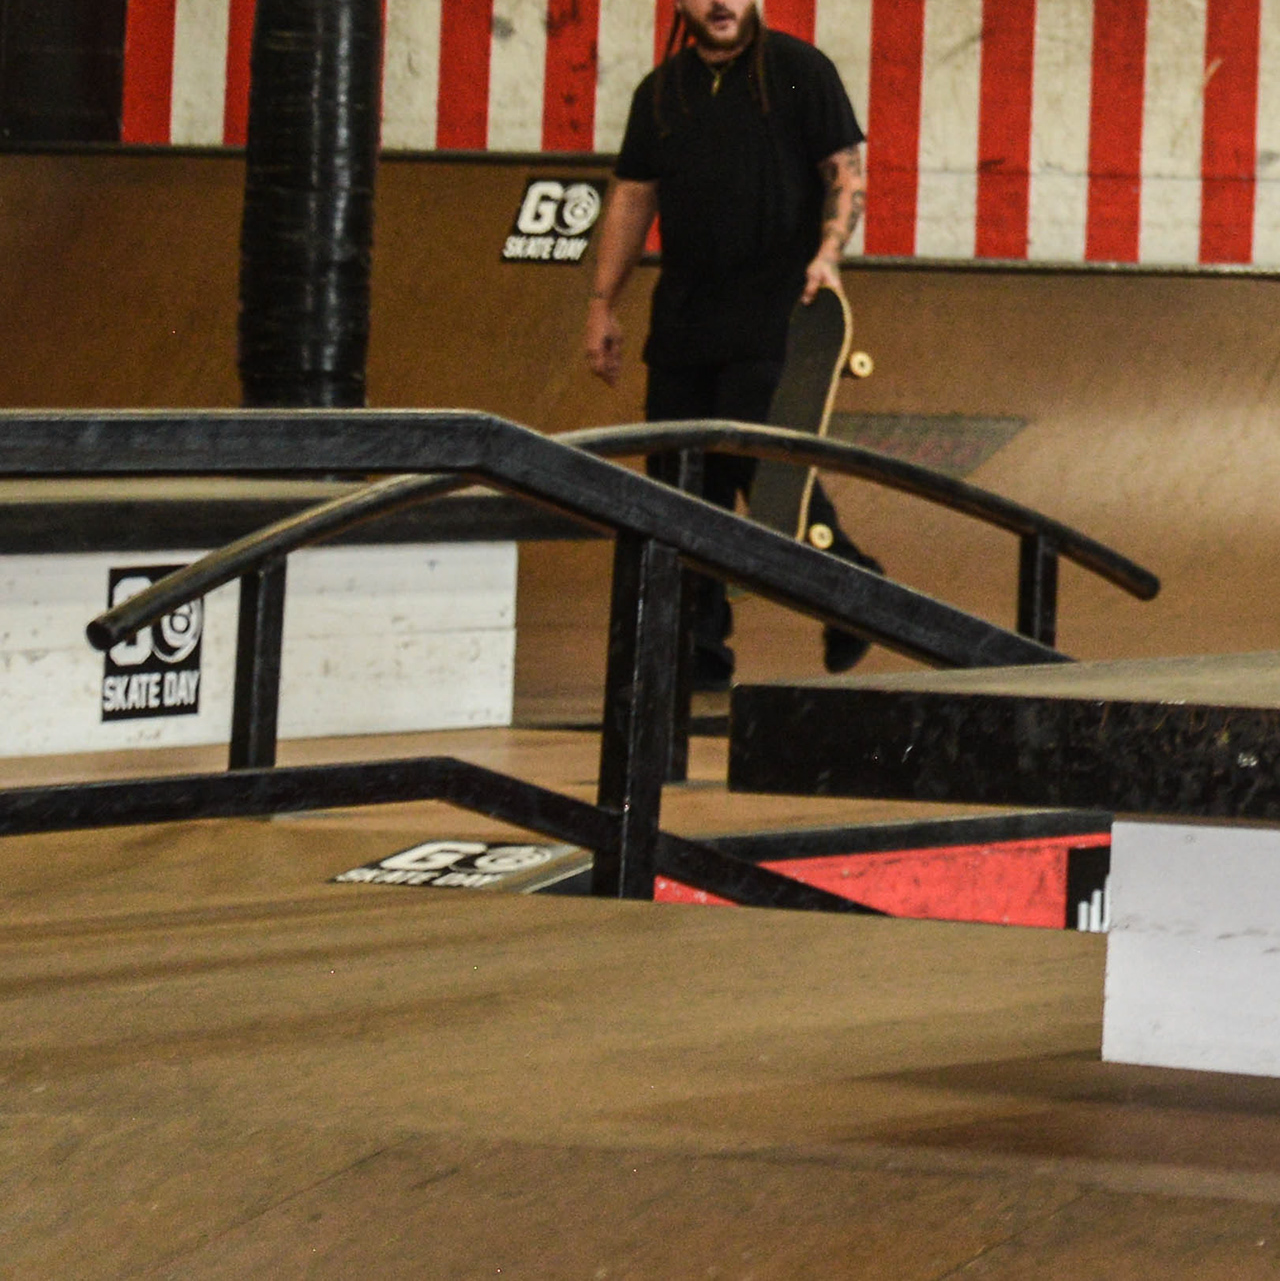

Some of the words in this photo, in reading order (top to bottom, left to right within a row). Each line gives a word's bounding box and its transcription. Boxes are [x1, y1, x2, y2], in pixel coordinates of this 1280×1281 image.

[502, 235, 556, 259] SKATE
[552, 237, 589, 260] DAY
[103, 672, 163, 712] SKATE
[162, 669, 200, 708] DAY
